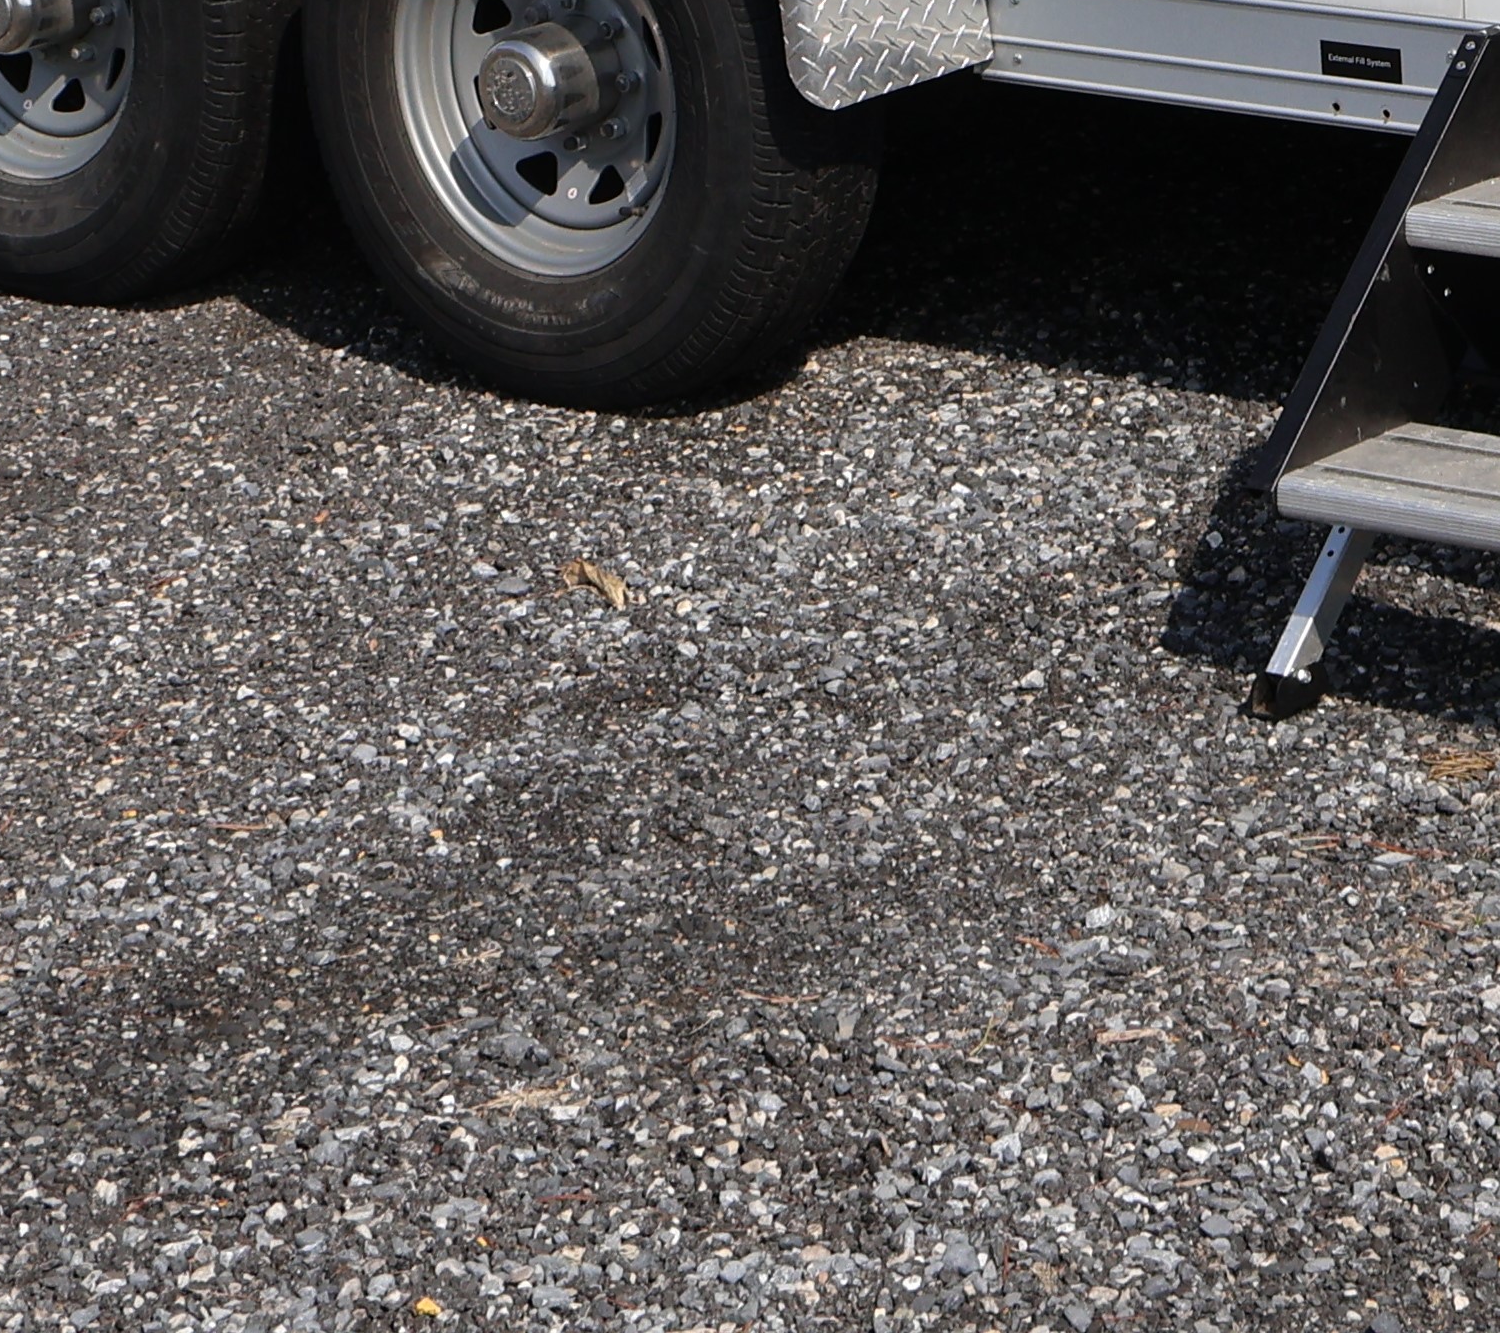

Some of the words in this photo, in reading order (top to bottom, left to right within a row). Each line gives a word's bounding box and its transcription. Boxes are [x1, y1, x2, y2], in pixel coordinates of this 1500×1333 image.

[1328, 53, 1354, 63] External
[1355, 56, 1366, 65] Fill
[1366, 58, 1391, 68] System
